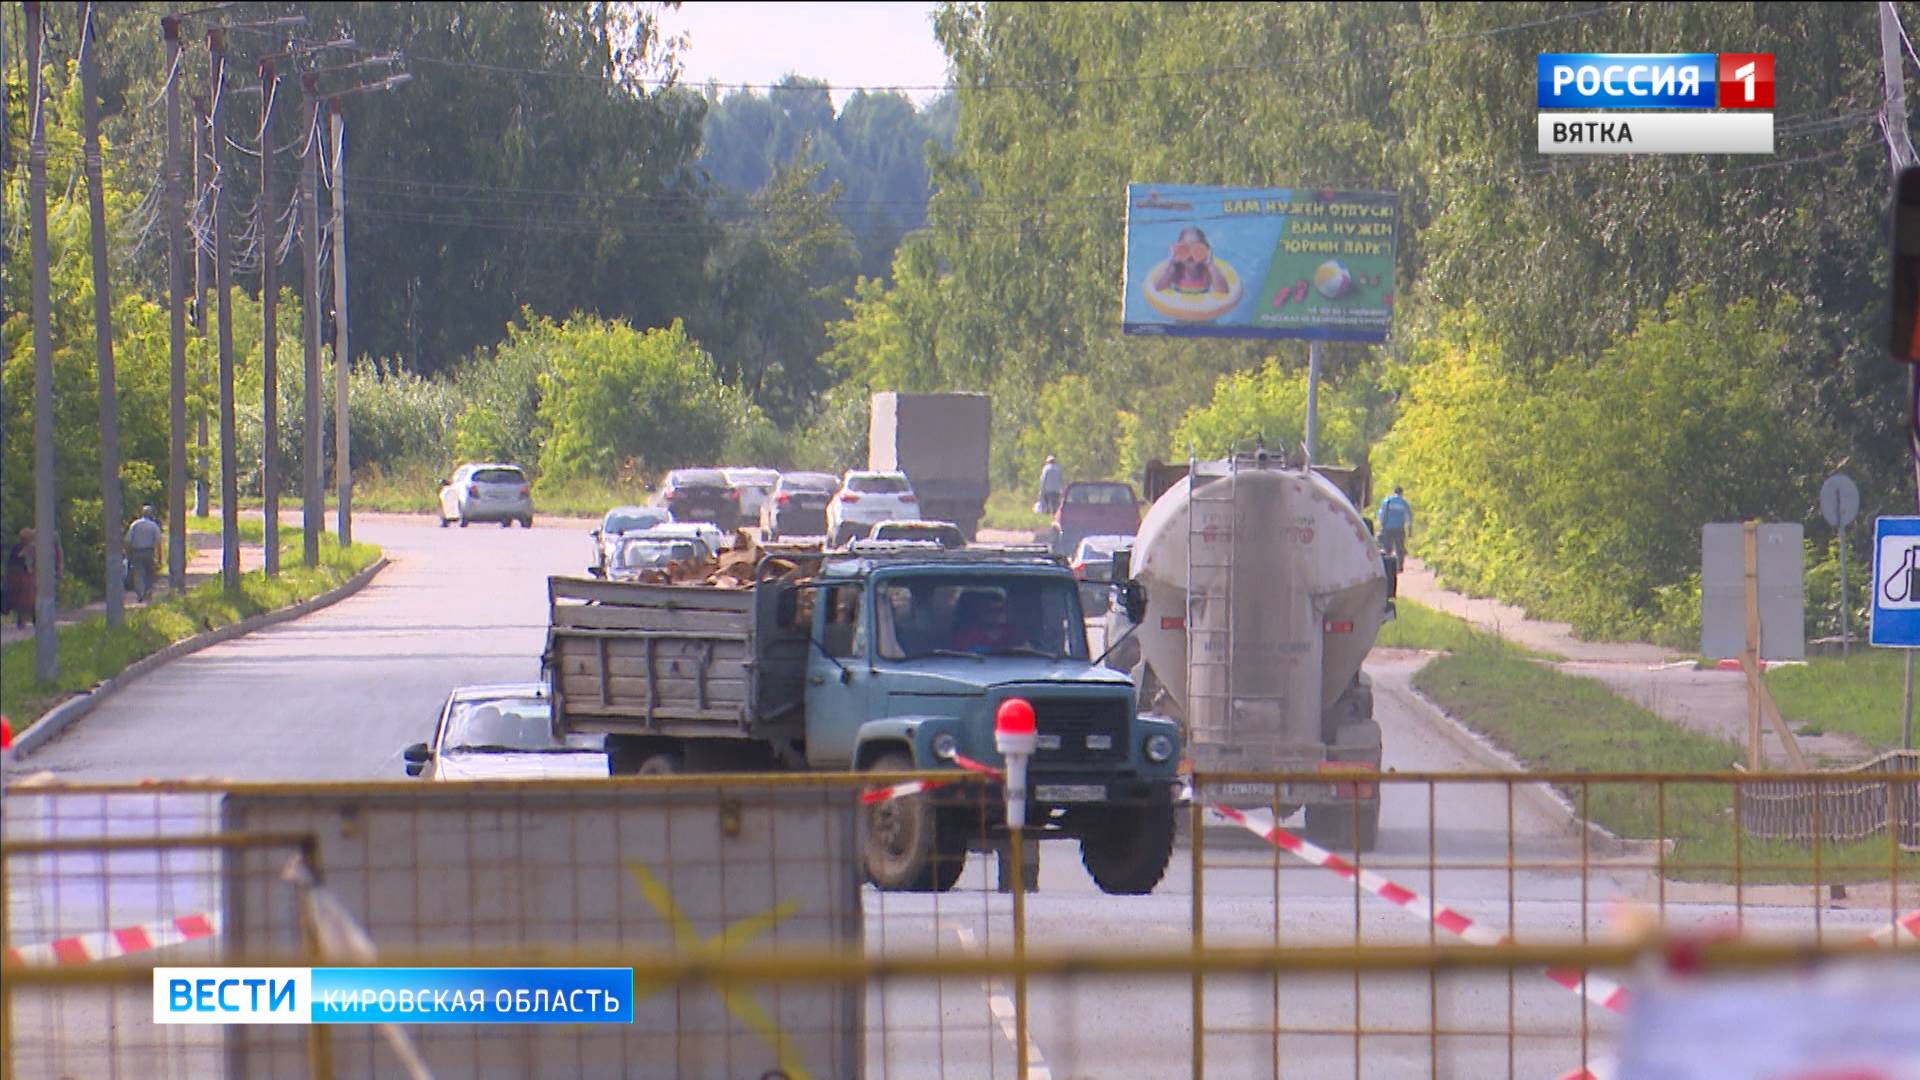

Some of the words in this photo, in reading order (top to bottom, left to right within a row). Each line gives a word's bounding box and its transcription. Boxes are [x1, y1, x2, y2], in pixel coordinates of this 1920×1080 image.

[1223, 200, 1261, 214] ВАМ
[1266, 201, 1325, 217] НУЖЕН
[1291, 221, 1328, 235] ВАМ
[1333, 222, 1393, 237] НУЖЕН
